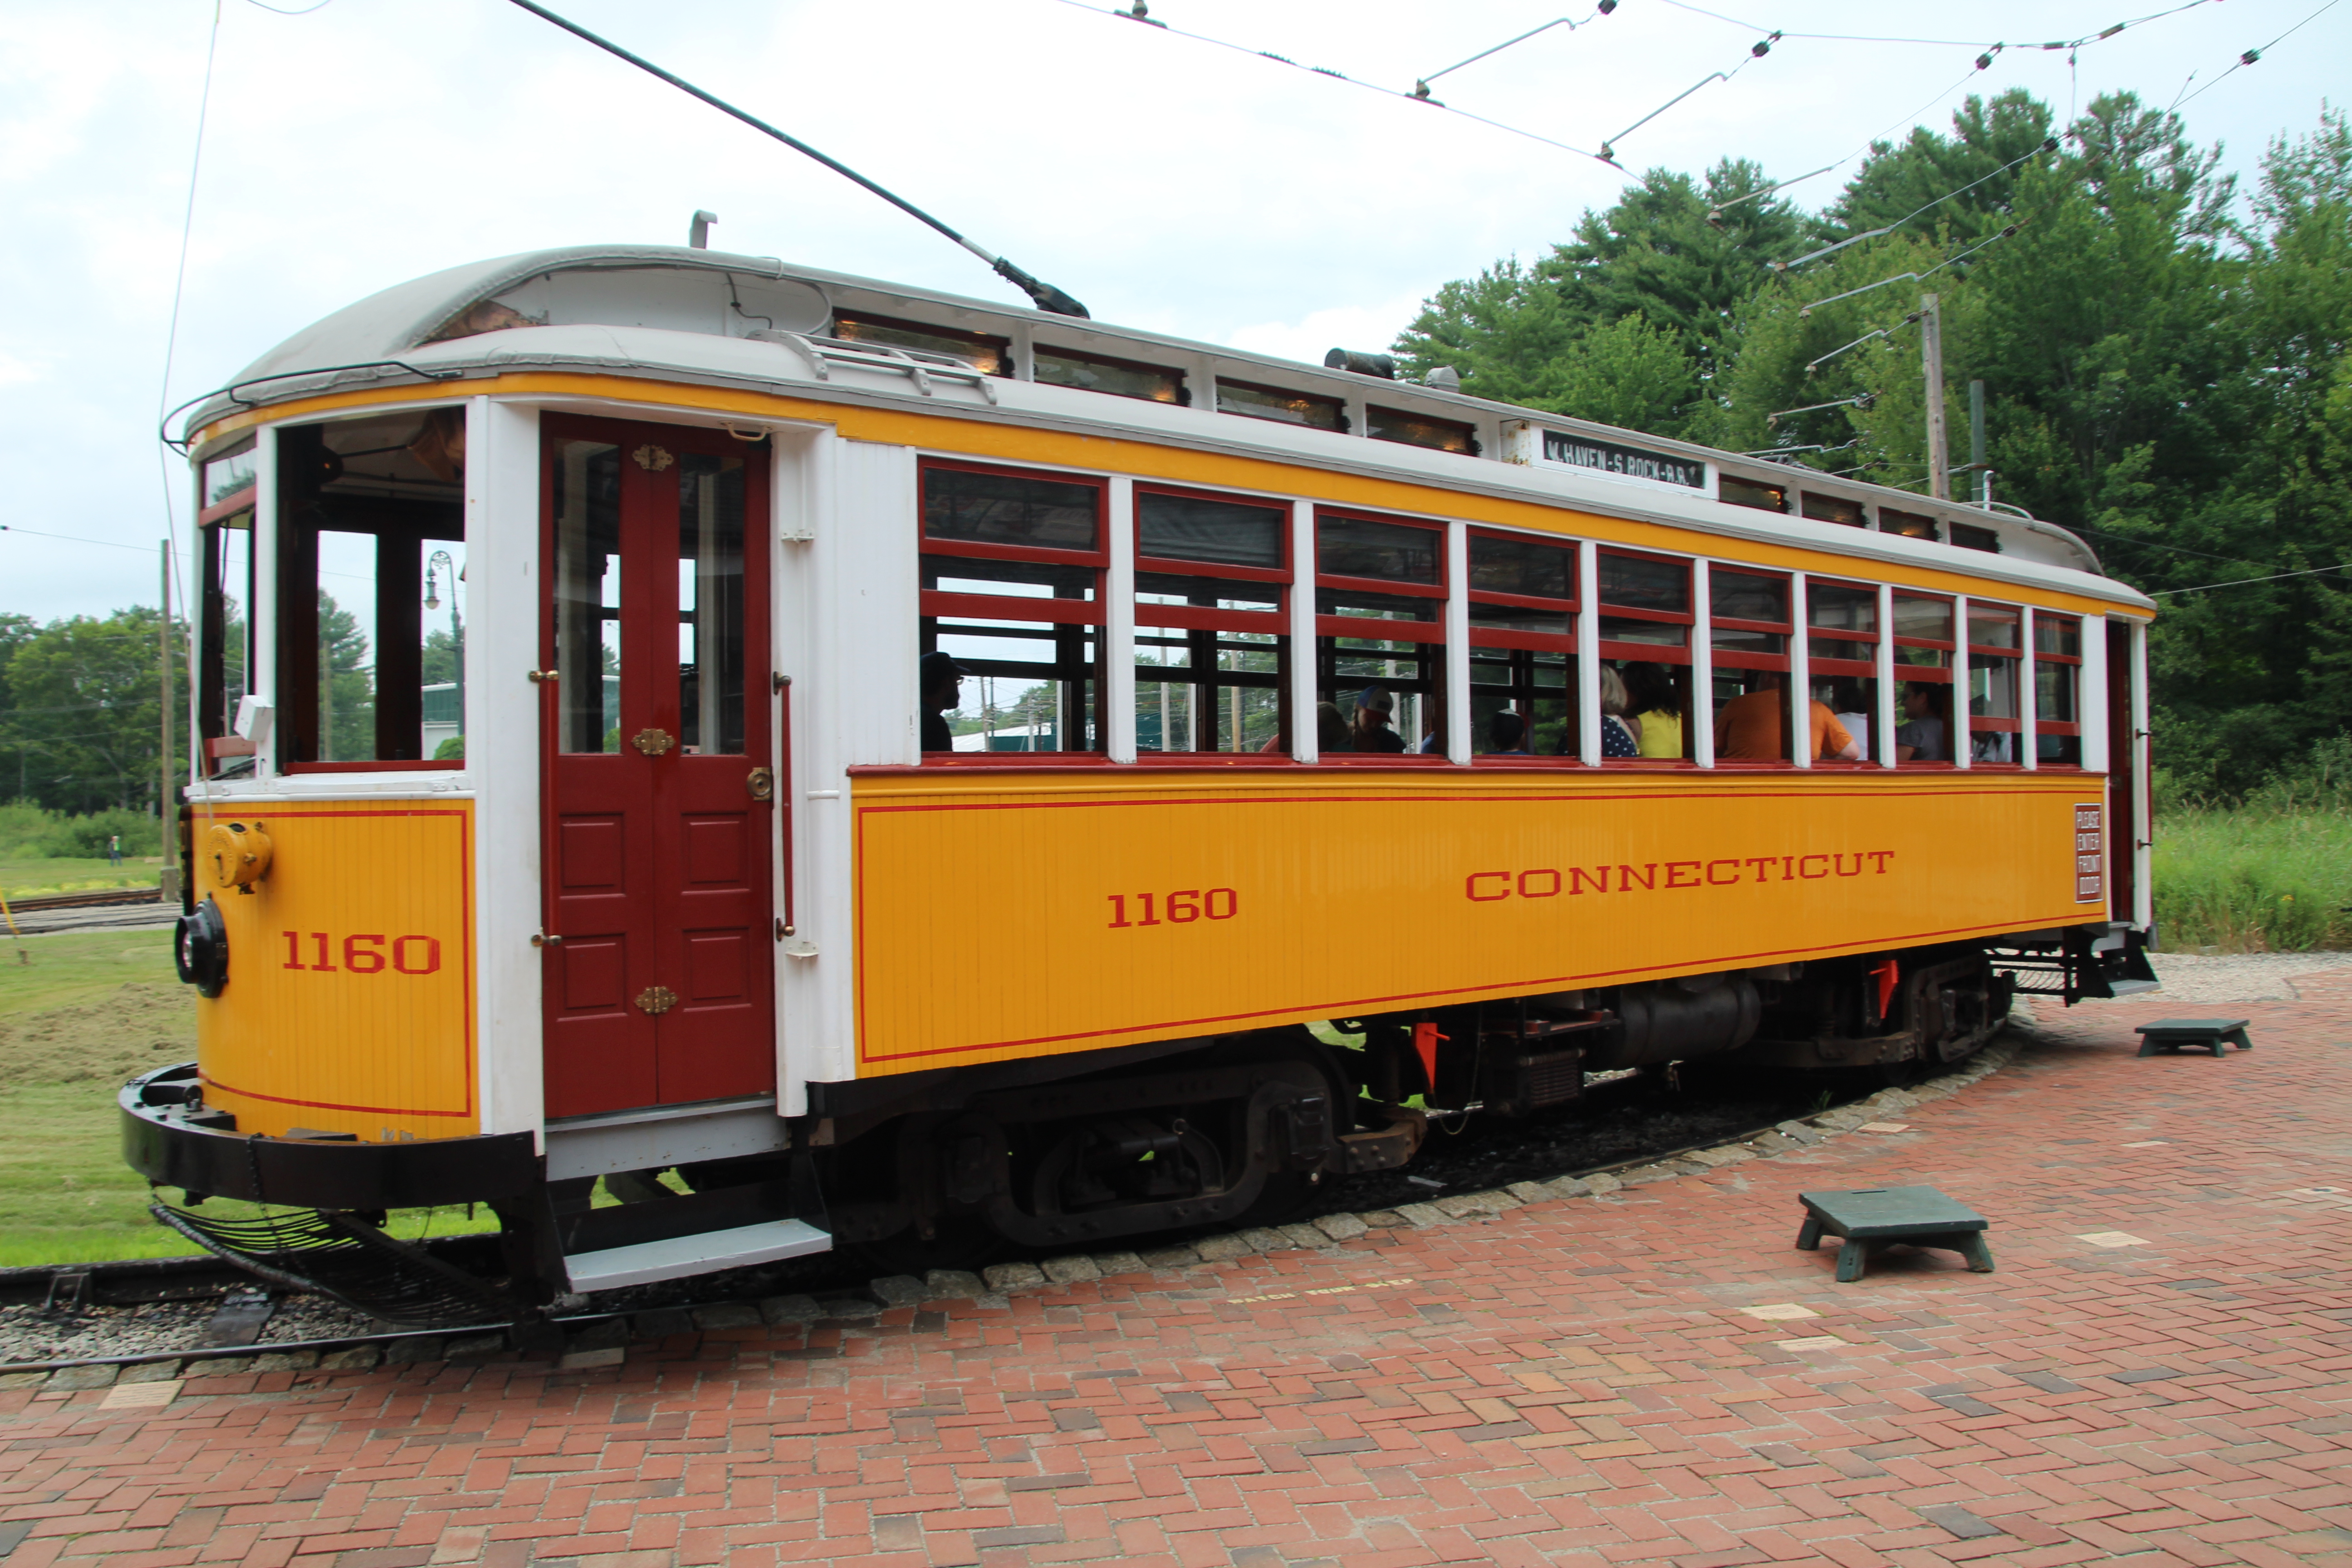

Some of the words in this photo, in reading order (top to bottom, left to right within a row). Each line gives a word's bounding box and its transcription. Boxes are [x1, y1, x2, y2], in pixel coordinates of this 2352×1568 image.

[2077, 833, 2101, 851] ENTER
[1466, 850, 1895, 902] CONNECTICUT
[2078, 854, 2102, 873] FRONT
[2079, 876, 2101, 895] DOOR
[1107, 887, 1238, 928] 1160
[283, 931, 441, 975] 1160
